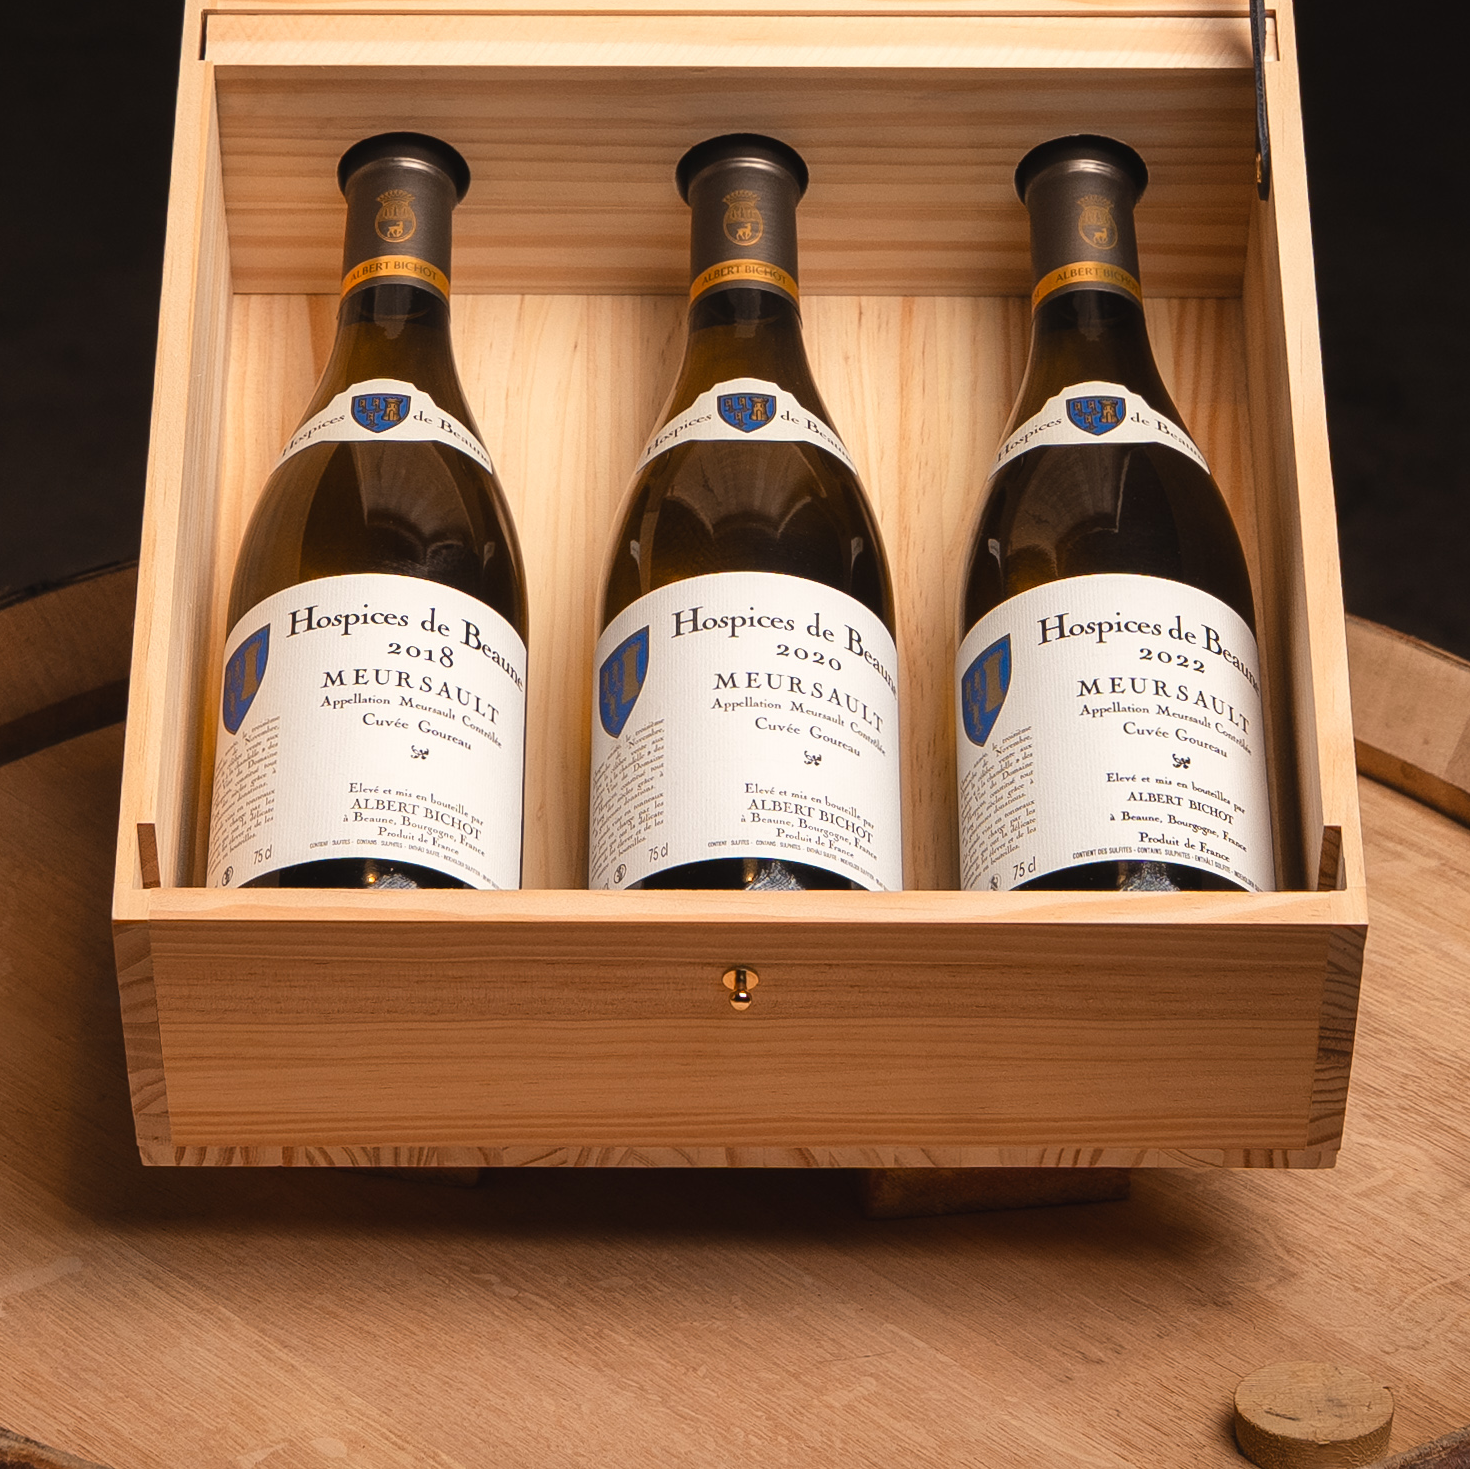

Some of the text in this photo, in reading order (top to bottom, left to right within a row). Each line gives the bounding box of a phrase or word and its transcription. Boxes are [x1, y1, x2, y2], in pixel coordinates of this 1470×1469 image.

[350, 261, 437, 283] ALBERT BICHOT
[702, 265, 787, 285] ALBERT BICHOT
[1055, 267, 1099, 283] ALBERT
[281, 410, 489, 464] Hospices de Beaune
[645, 414, 712, 457] Hospices
[781, 410, 800, 425] de
[997, 418, 1062, 462] Hospices
[1131, 413, 1149, 425] de
[671, 606, 795, 638] Hospices
[807, 613, 834, 642] de
[1037, 611, 1162, 646] Hospices
[1169, 616, 1197, 644] de
[286, 604, 524, 692] Hospices de Beaune
[387, 642, 454, 668] 2018
[776, 644, 842, 671] 2020
[1139, 648, 1206, 674] 2022
[320, 668, 500, 725] MEURSAULT
[320, 694, 390, 708] Appellation
[398, 696, 455, 720] Meursault
[711, 697, 781, 712] Appellation
[790, 700, 845, 727] Meursault
[712, 672, 884, 733] MEURSAULT
[1077, 677, 1250, 735] MEURSAULT
[362, 713, 471, 750] Cuvée Goureau
[1079, 702, 1149, 717] Appellation
[1156, 705, 1211, 730] Meursault
[755, 716, 861, 757] Cuvée Goureau
[1123, 721, 1228, 758] Cuvée Goureau
[348, 783, 379, 794] Elevé
[396, 789, 412, 798] mis
[471, 816, 484, 827] par
[1106, 772, 1246, 814] Elevé et mis en bouteilles par
[1127, 791, 1234, 826] ALBERT BICHOT
[343, 812, 485, 856] à Beaune, Bourgogne, France
[350, 799, 482, 840] ALBERT BICHOT
[748, 799, 874, 844] ALBERT BICHOT
[1110, 811, 1248, 853] à Beaune, Bourgogne, France
[253, 845, 272, 865] 75 cl
[378, 826, 459, 855] Produit de France
[649, 843, 668, 863] 75 cl
[776, 828, 855, 859] Produit de France
[1138, 831, 1230, 863] Produit de France
[1012, 858, 1036, 880] 75 cl
